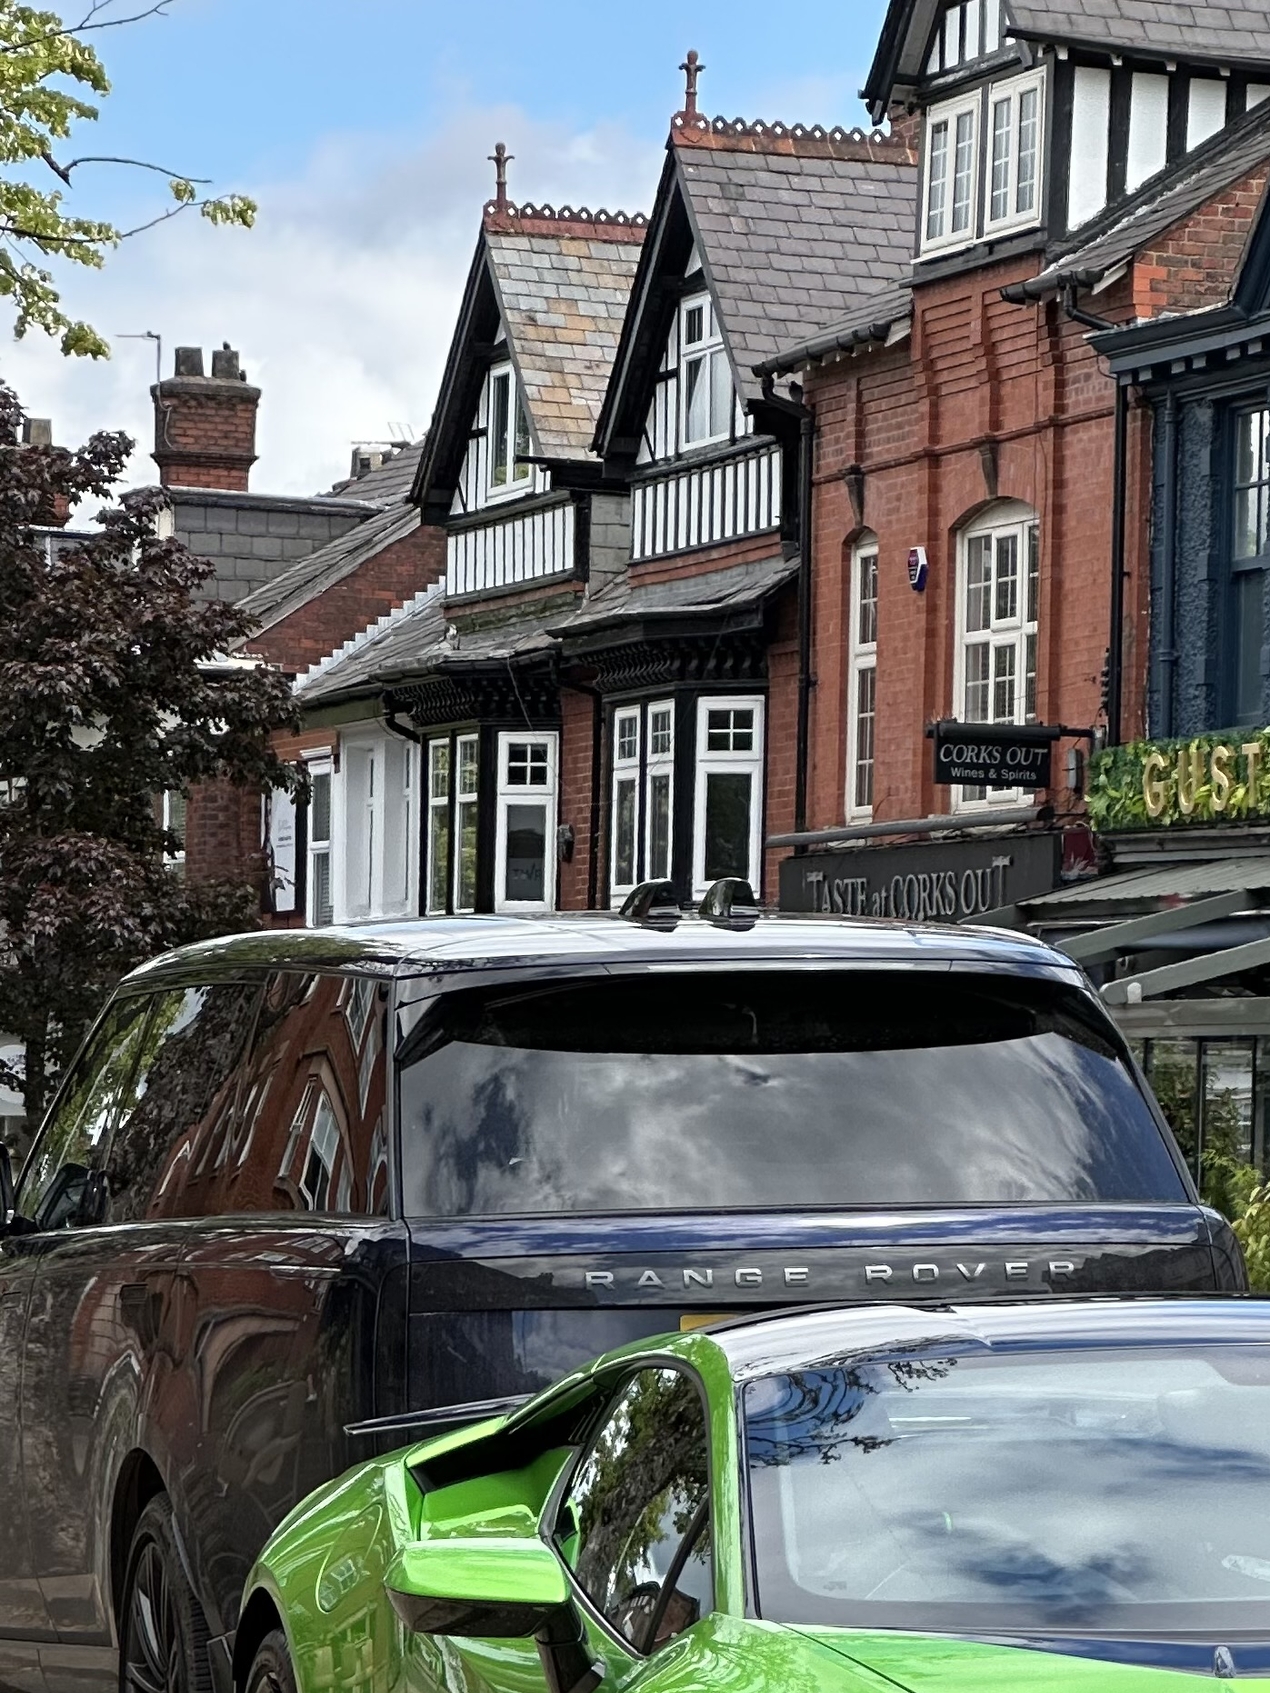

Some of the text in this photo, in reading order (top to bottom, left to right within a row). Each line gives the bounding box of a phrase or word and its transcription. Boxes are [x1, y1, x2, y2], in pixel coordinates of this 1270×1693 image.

[940, 743, 1048, 766] CORKS OUT
[950, 767, 1036, 781] Wines & Spirits
[806, 855, 1011, 921] TASTE at CORKS OUT
[585, 1261, 1077, 1291] RANGE ROVER
